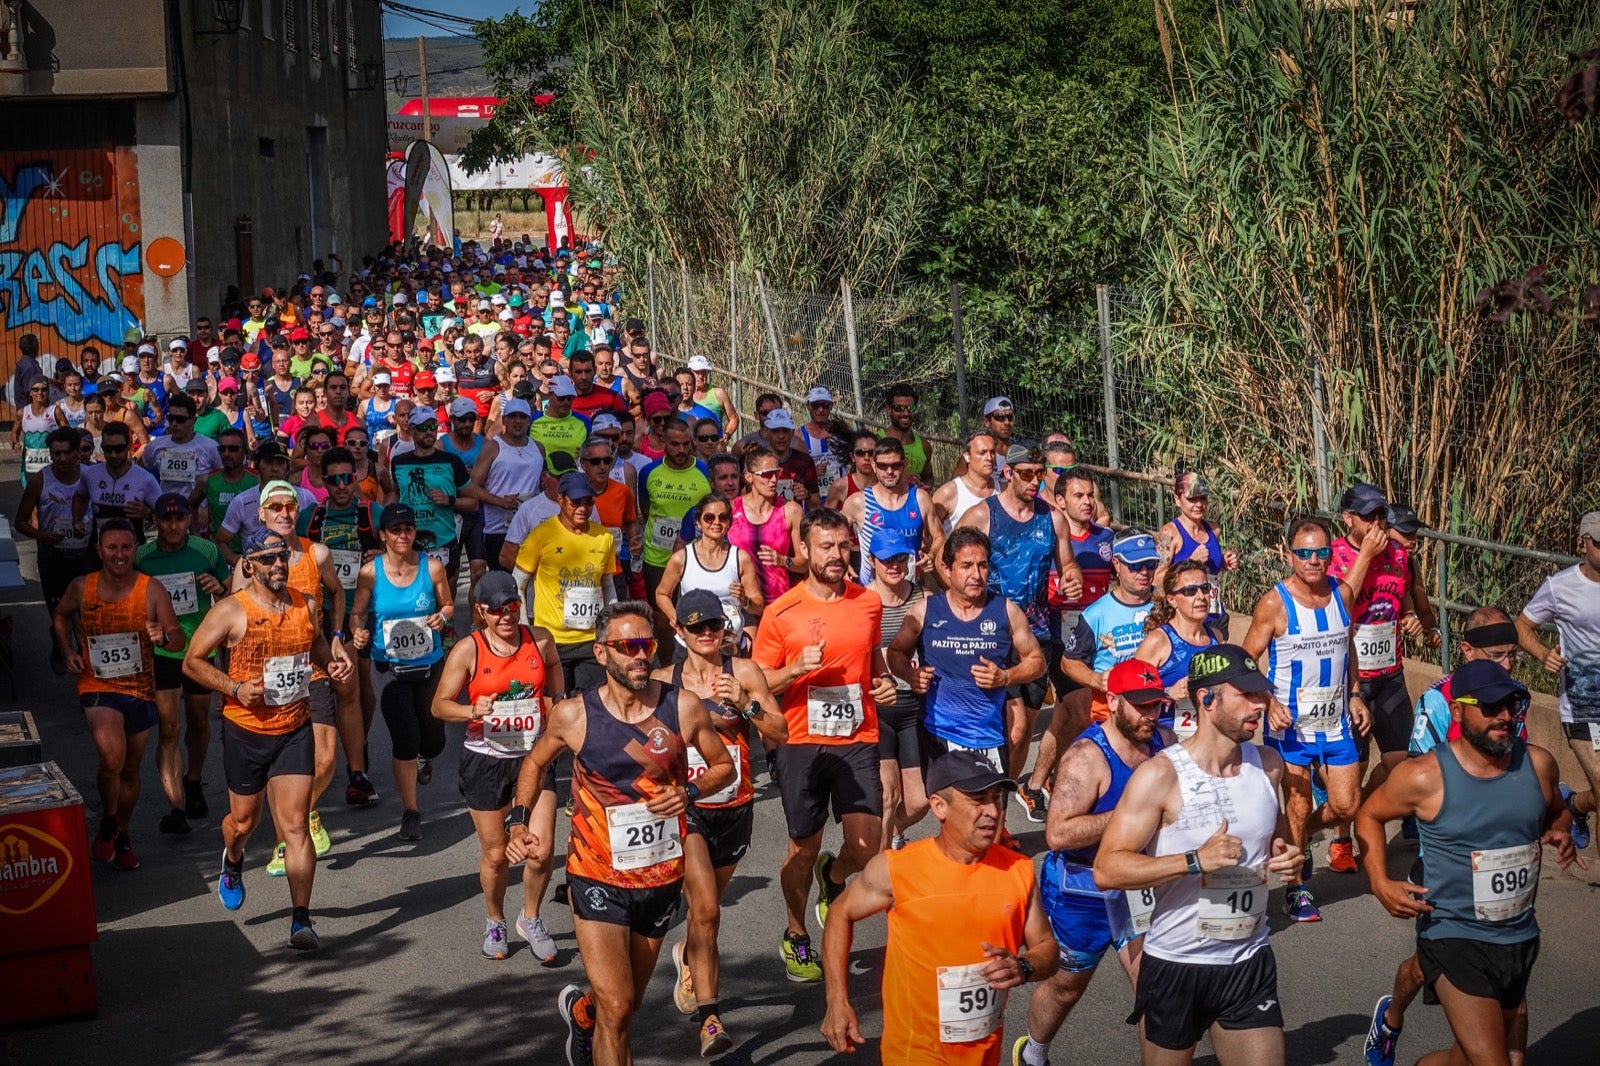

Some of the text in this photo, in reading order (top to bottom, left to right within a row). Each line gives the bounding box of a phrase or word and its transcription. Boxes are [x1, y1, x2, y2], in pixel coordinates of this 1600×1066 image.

[167, 459, 188, 471] 269
[100, 493, 126, 504] ARCOS
[571, 603, 600, 617] 3015
[983, 622, 993, 631] 30
[392, 632, 426, 649] 3013
[932, 640, 961, 649] PAZITO
[969, 641, 998, 649] PAZITO
[1292, 641, 1321, 650] PAZITO
[1361, 639, 1391, 656] 3050
[100, 647, 131, 664] 353
[276, 670, 304, 688] 355
[822, 703, 855, 719] 349
[1310, 702, 1336, 718] 418
[490, 715, 535, 733] 2190
[626, 820, 666, 847] 287
[1227, 890, 1253, 914] 10
[959, 985, 997, 1013] 597
